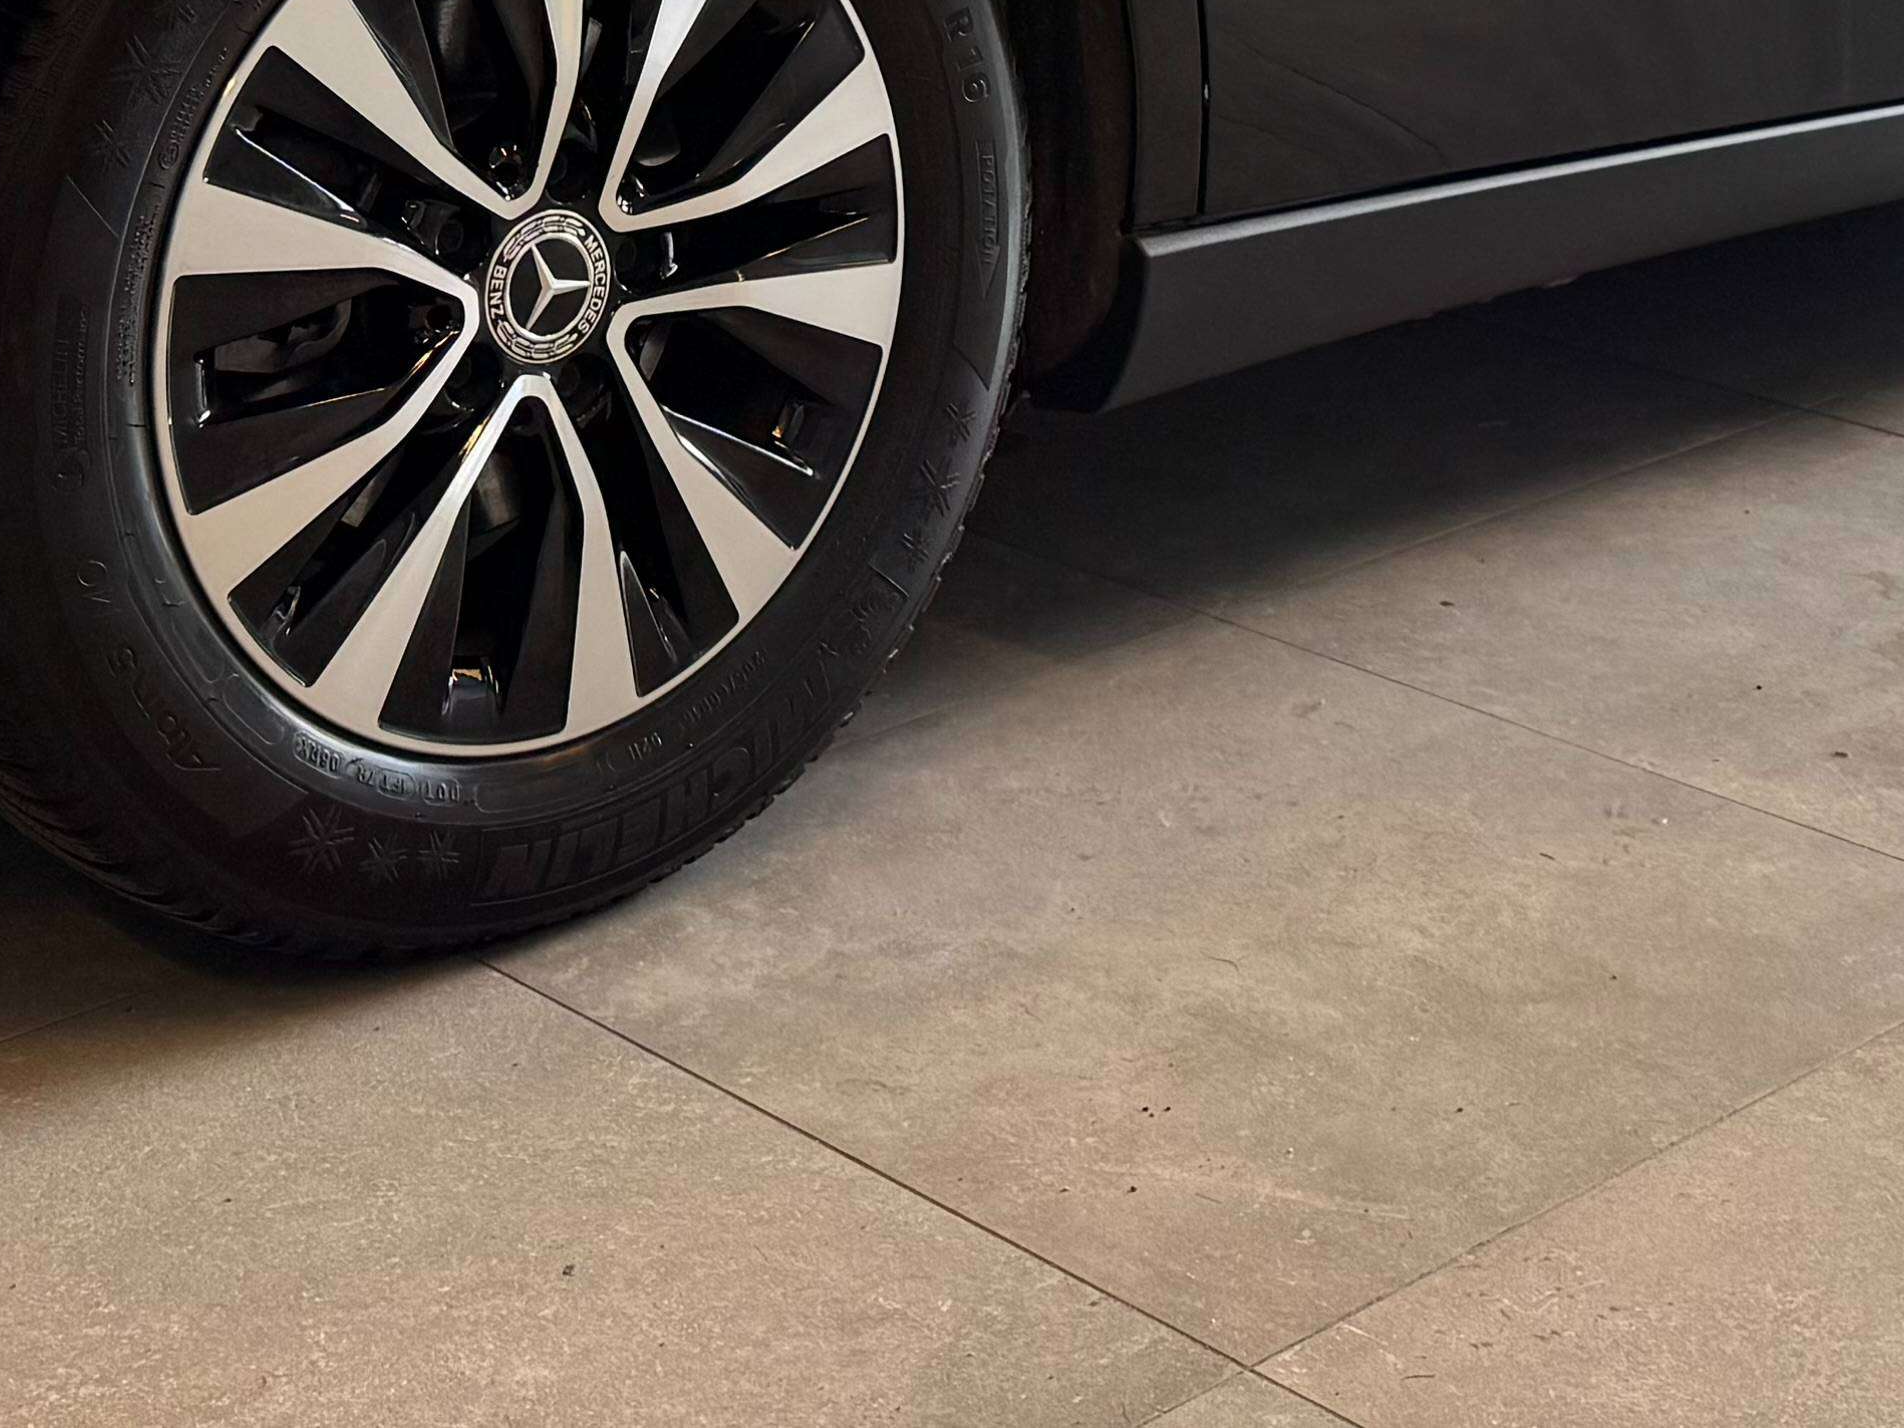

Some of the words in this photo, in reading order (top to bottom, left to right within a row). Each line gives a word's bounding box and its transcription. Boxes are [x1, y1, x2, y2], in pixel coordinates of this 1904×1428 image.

[945, 6, 975, 42] R
[953, 44, 993, 104] 16
[979, 153, 998, 265] ROTATION
[489, 264, 508, 320] BENZ
[578, 234, 607, 334] MERCEDES
[422, 779, 461, 802] DOT
